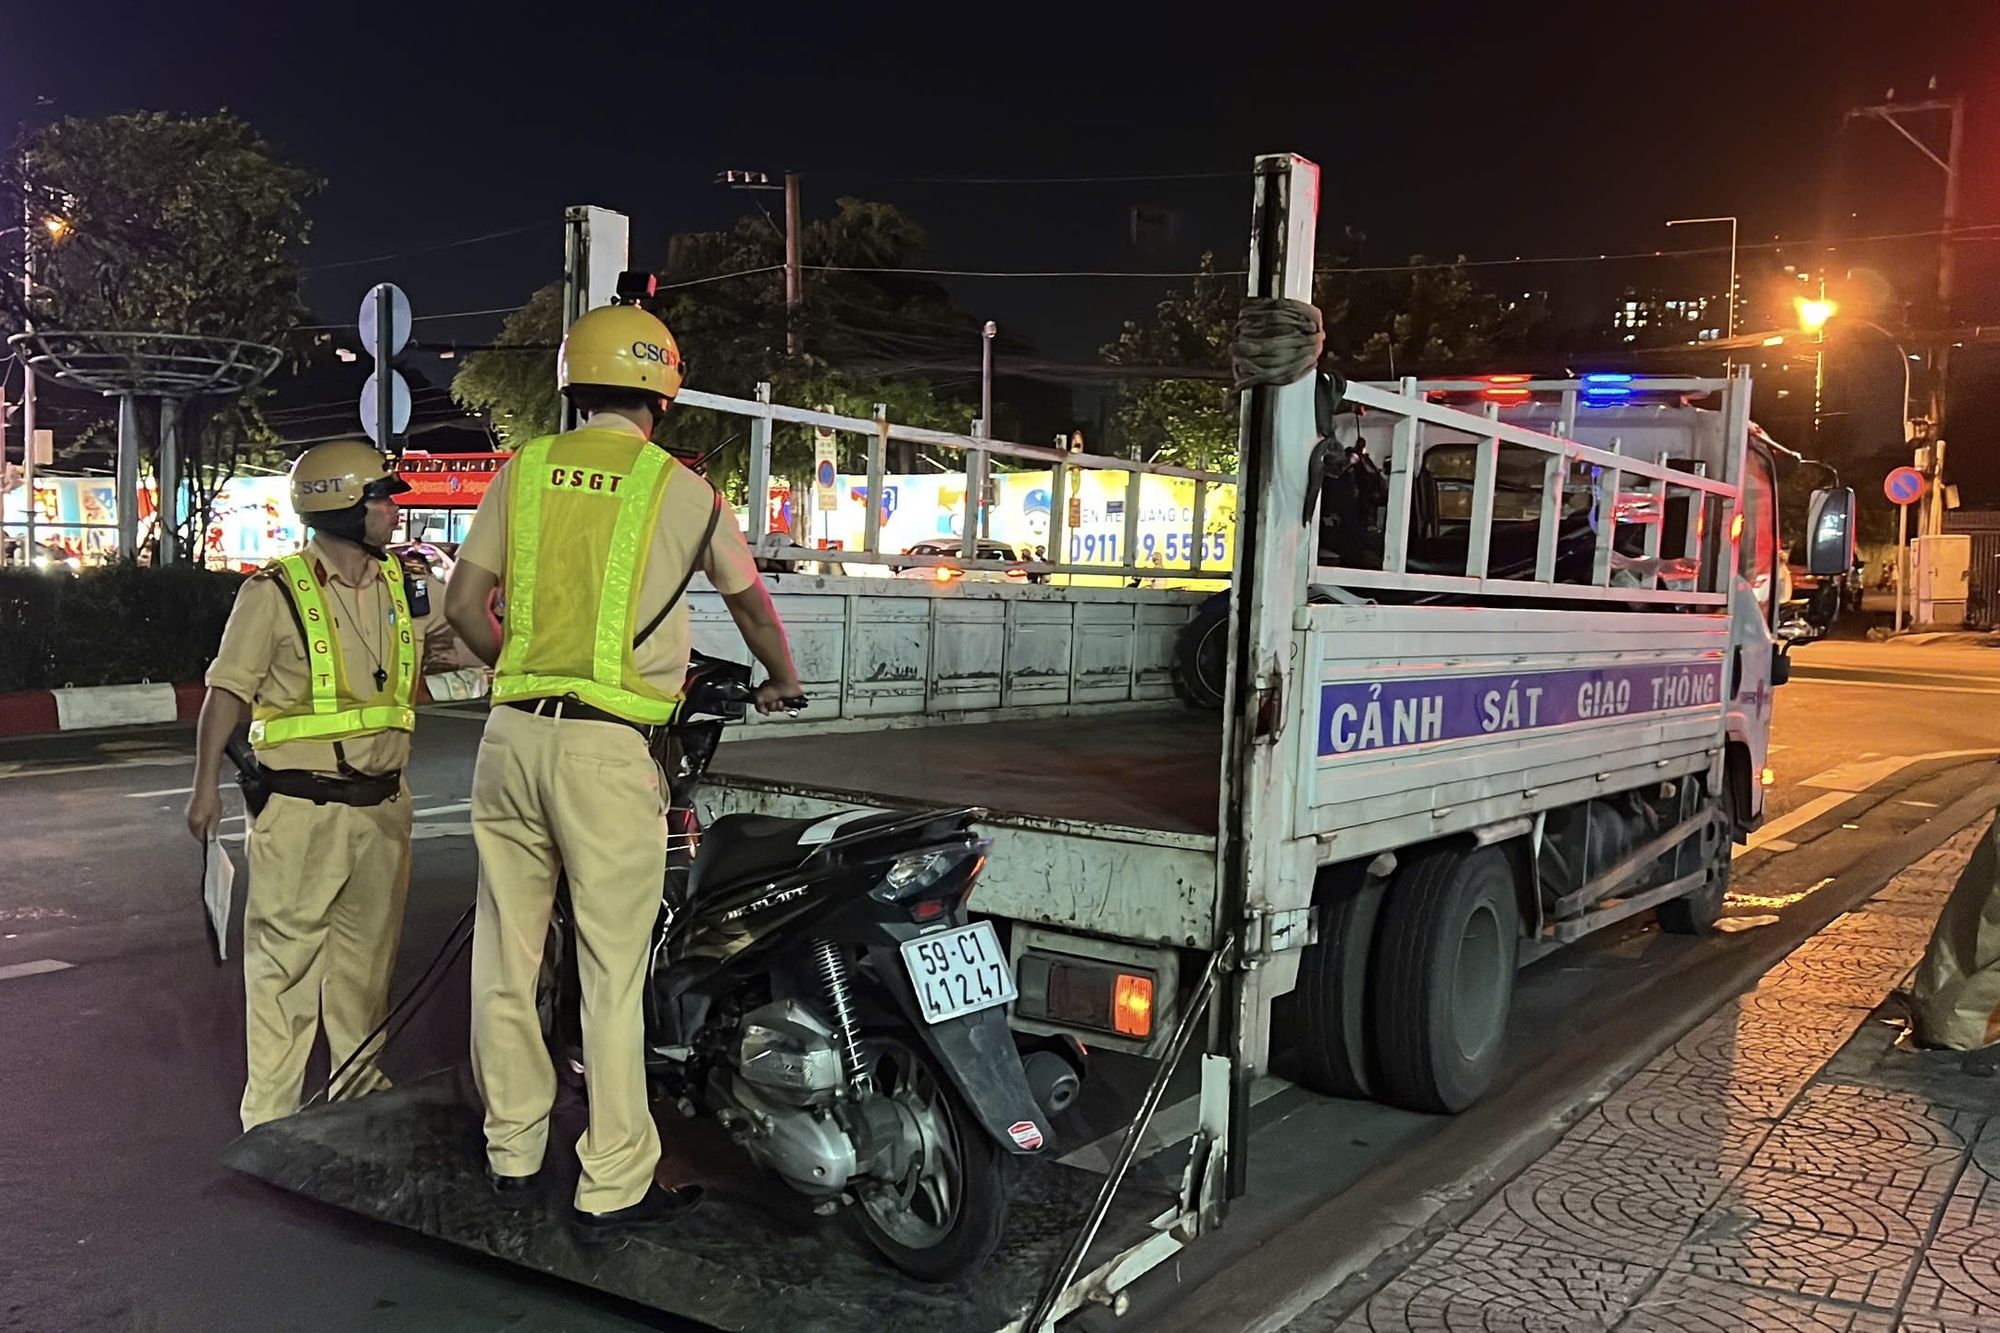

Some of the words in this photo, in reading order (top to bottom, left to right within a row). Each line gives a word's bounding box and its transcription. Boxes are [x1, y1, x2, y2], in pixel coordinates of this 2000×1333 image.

[632, 341, 677, 366] CSG
[551, 468, 623, 493] CSGT
[1330, 683, 1443, 753] CẢNH
[1482, 680, 1543, 733] SÁT
[1577, 678, 1630, 719] GIAO
[1651, 667, 1713, 710] THÔNG
[924, 963, 1008, 1015] 412.47
